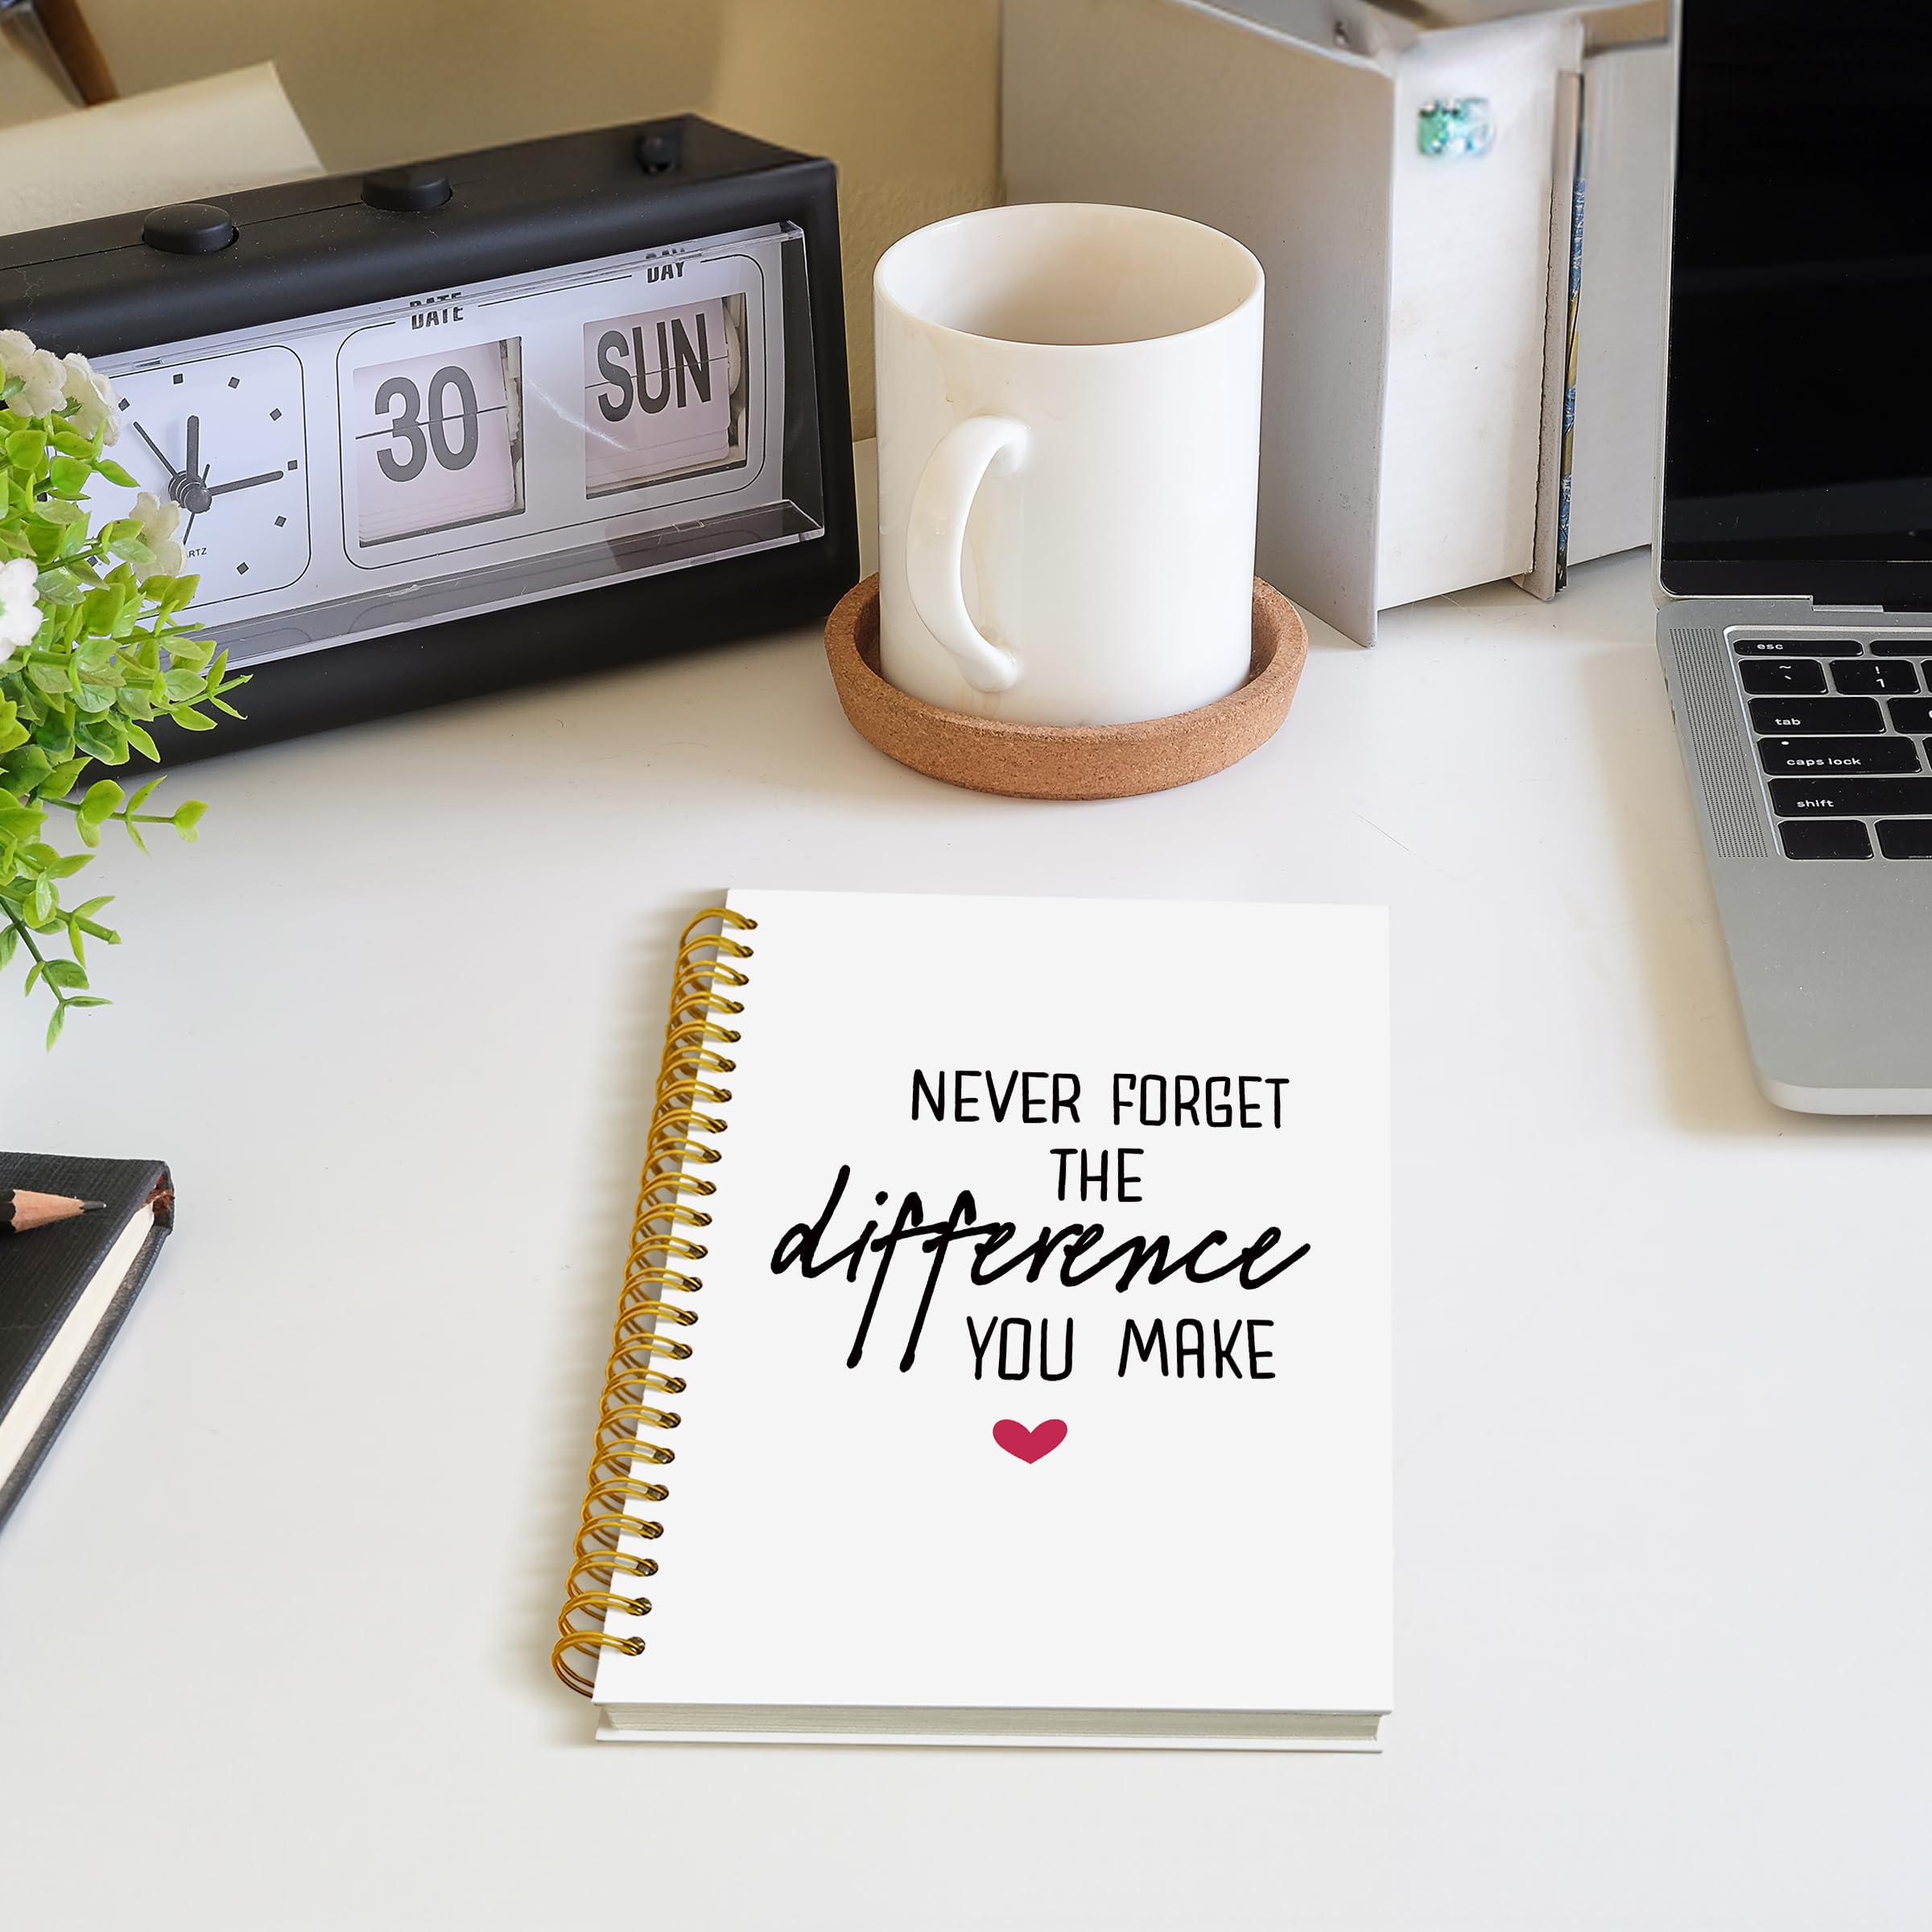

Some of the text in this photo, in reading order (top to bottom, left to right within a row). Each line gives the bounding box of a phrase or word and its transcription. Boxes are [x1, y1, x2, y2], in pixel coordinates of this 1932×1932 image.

[646, 248, 685, 283] DAY
[410, 292, 464, 330] DATE
[597, 313, 711, 422] SUN
[374, 366, 478, 483] 30
[187, 547, 207, 558] RTZ
[1876, 678, 1885, 688] 1
[1774, 717, 1801, 725] tab
[1786, 758, 1862, 767] caps lock
[1797, 799, 1835, 807] shift
[911, 1069, 1290, 1129] NEVER FORGET
[1049, 1148, 1145, 1203] THE
[770, 1164, 1311, 1373] difference
[966, 1315, 1276, 1381] YOU MAKE
